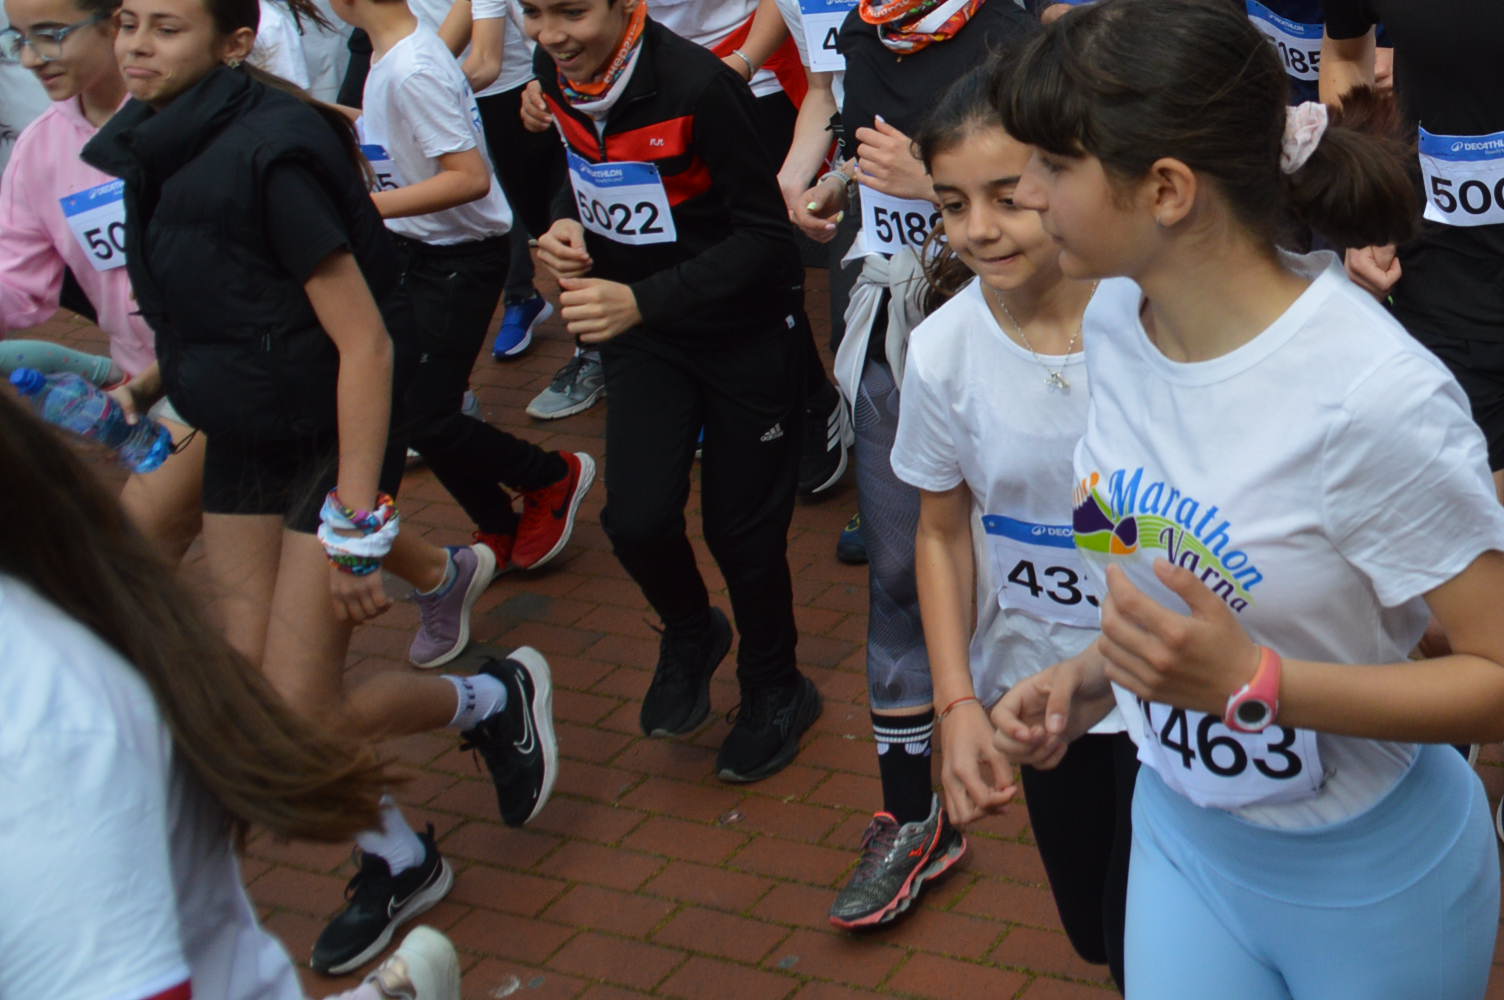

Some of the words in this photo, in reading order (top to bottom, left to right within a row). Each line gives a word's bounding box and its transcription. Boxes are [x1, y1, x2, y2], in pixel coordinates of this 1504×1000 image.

[1265, 36, 1321, 74] 185
[577, 189, 664, 236] 5022
[83, 221, 128, 260] 50
[1108, 466, 1264, 592] Marathon
[1008, 559, 1100, 608] 43
[1159, 526, 1249, 614] Varna
[1142, 697, 1303, 780] 463
